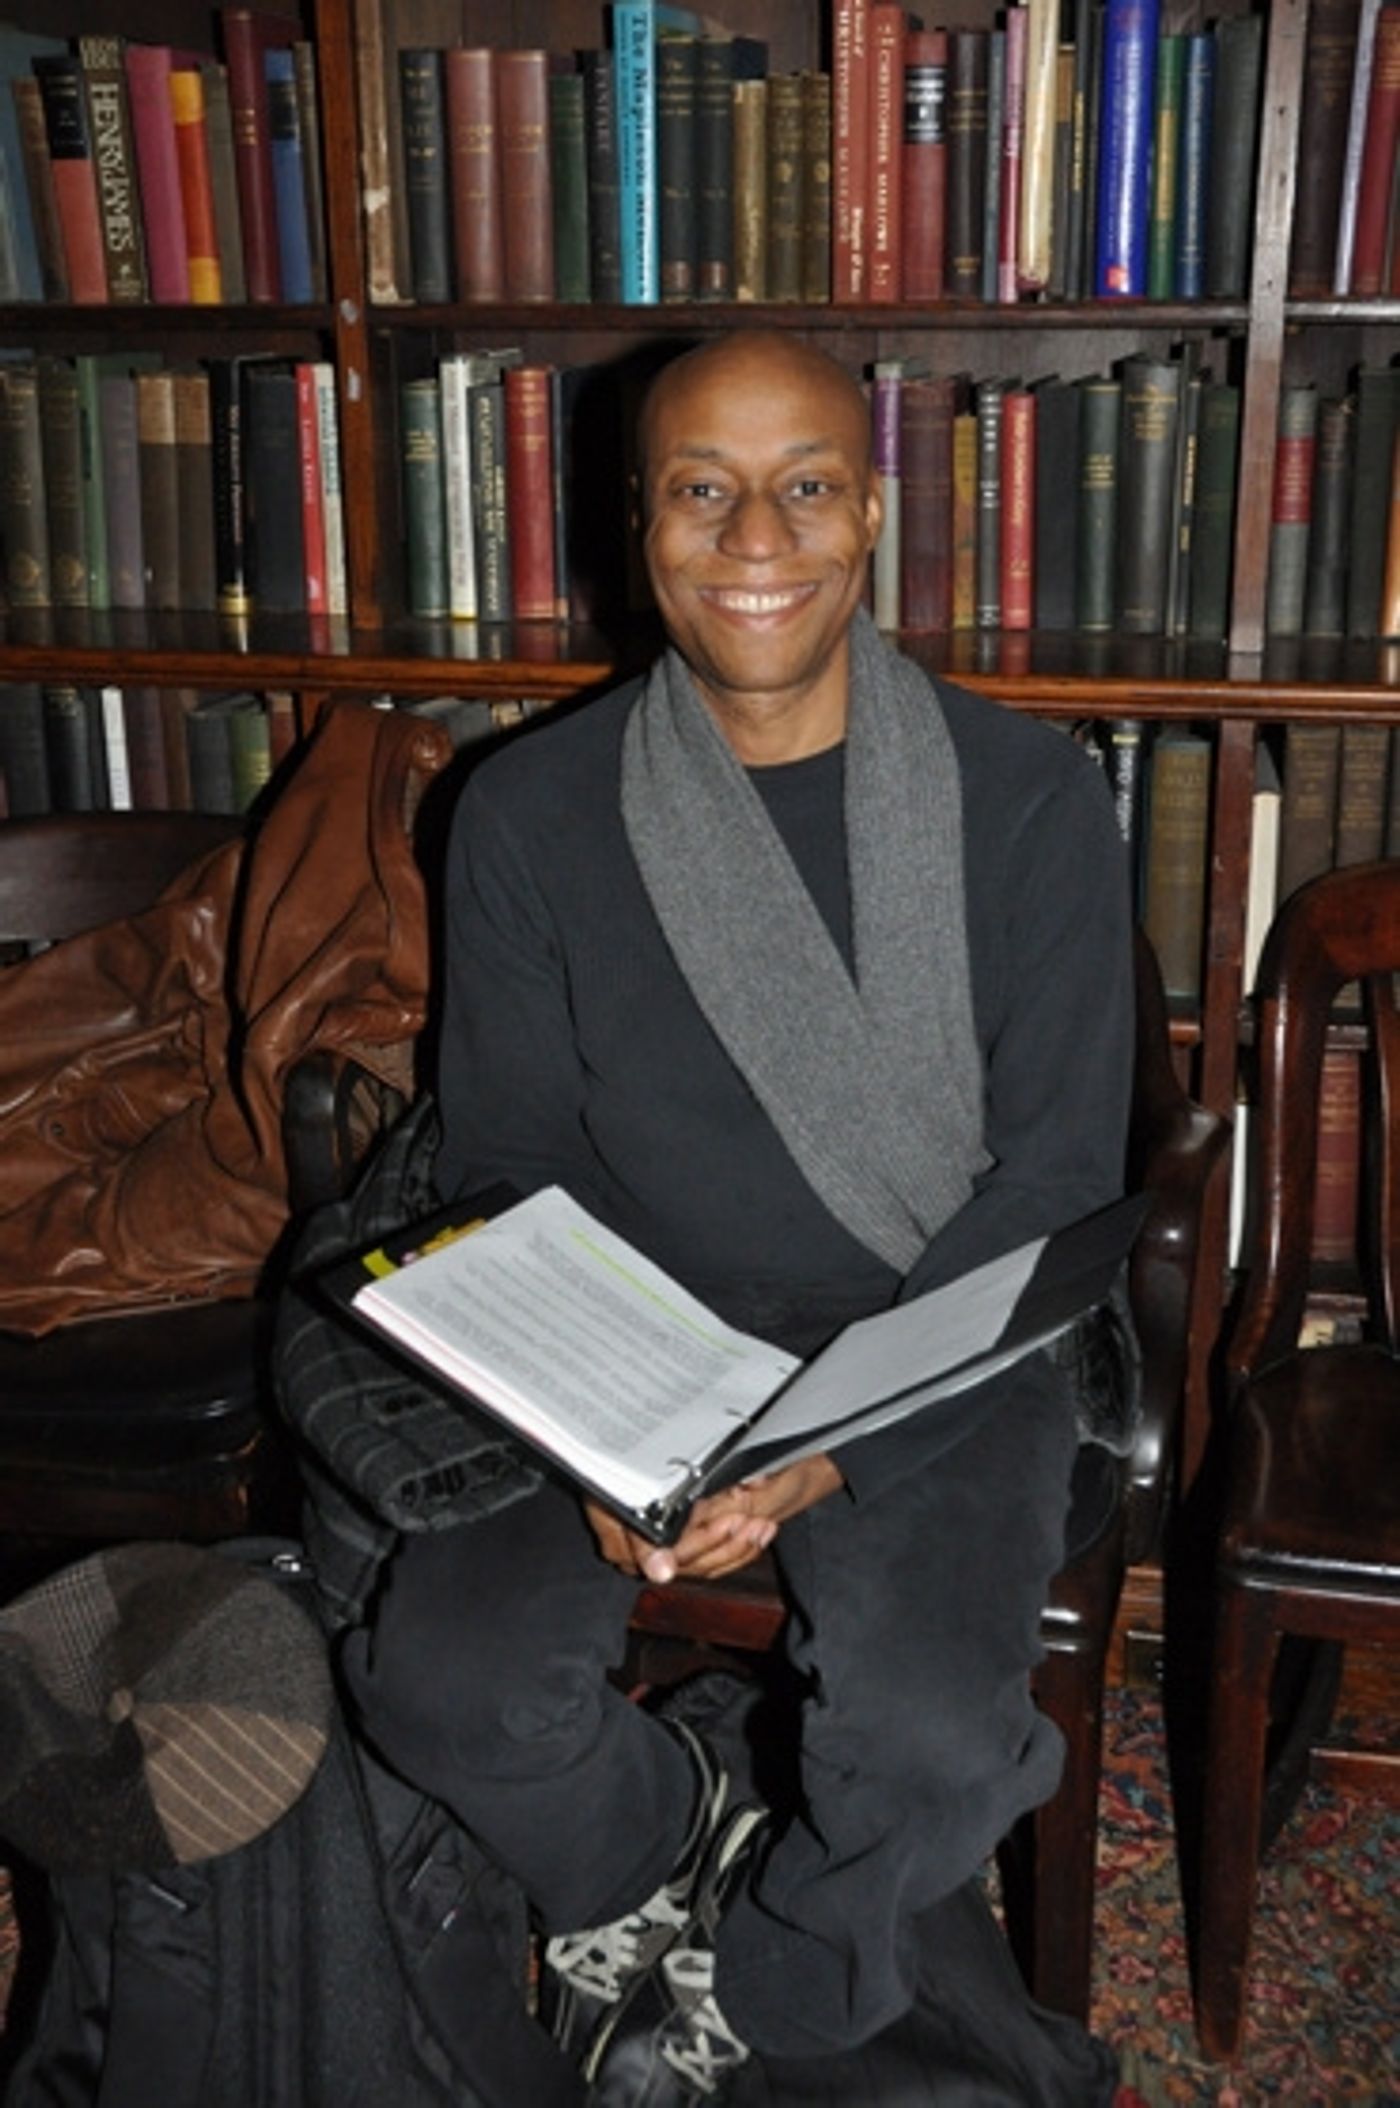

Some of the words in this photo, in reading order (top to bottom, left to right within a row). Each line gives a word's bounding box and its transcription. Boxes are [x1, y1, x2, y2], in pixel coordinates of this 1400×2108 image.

[632, 12, 649, 59] The
[91, 82, 124, 169] HENRY
[876, 48, 891, 165] CHRISTOPHER
[103, 169, 134, 252] JAMES
[875, 173, 888, 252] MARLOWE
